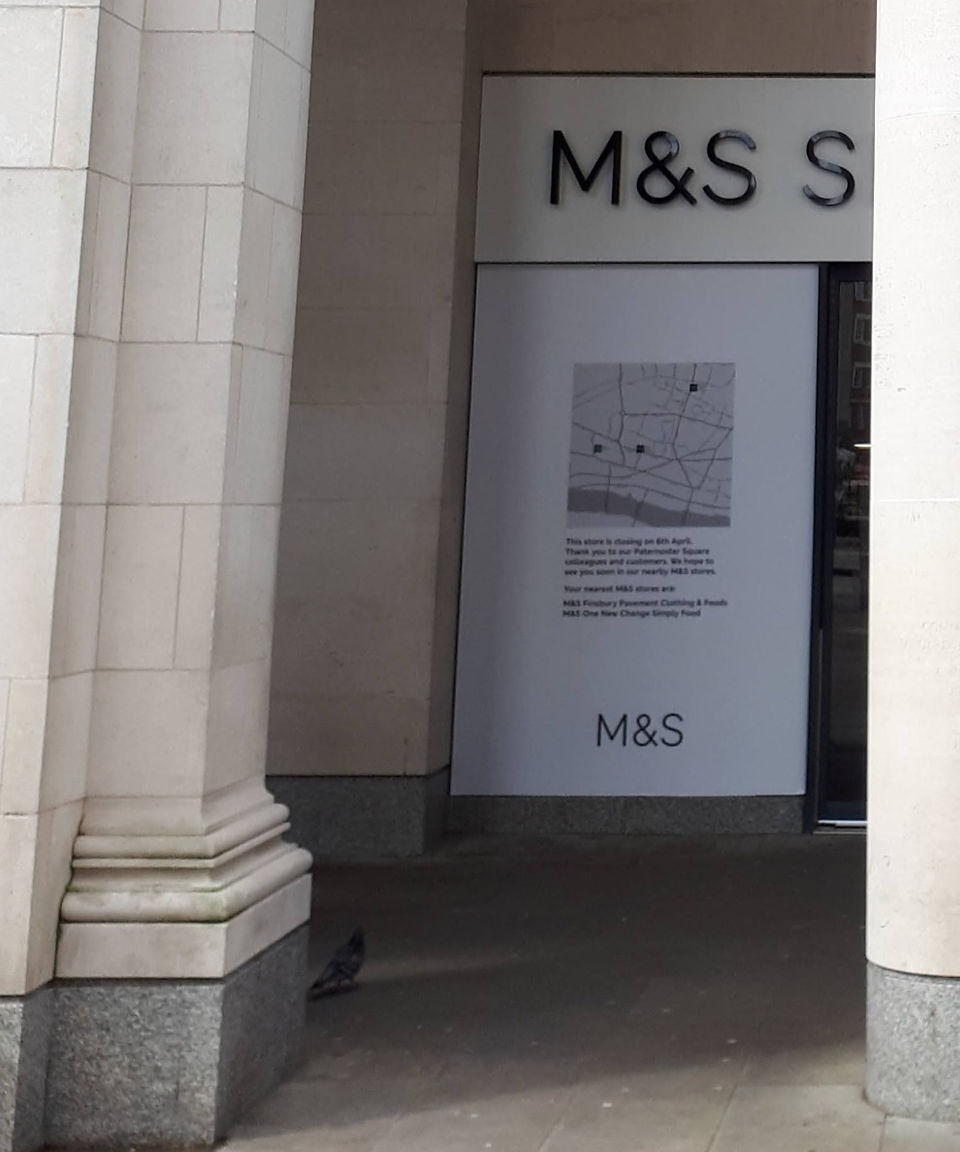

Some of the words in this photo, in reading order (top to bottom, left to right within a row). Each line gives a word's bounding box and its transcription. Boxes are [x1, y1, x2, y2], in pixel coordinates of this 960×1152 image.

[549, 130, 758, 207] M&S
[592, 549, 607, 557] you
[682, 548, 710, 557] Square
[614, 538, 642, 547] closing
[597, 712, 684, 747] M&S
